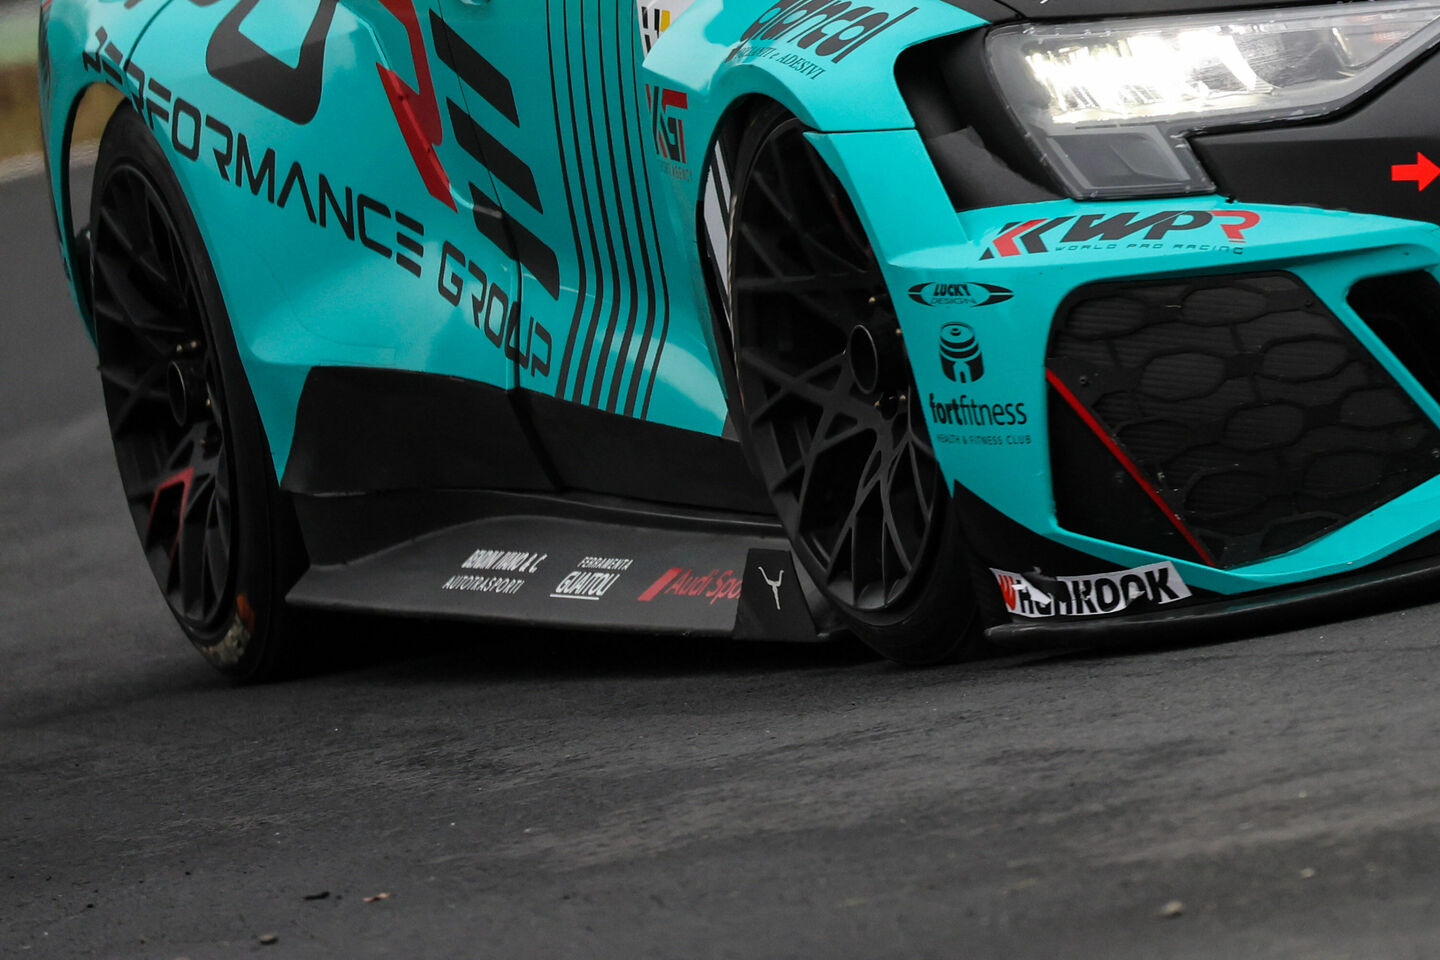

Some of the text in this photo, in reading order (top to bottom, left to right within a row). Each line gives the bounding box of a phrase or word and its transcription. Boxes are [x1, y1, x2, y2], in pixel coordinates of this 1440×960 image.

[776, 53, 827, 81] ADESIVI
[1055, 243, 1118, 252] WORLD
[1125, 242, 1164, 250] PRO
[933, 284, 971, 296] LUCKY
[438, 240, 553, 378] GROUP
[929, 392, 1028, 426] fortfitness
[442, 574, 526, 595] AUTOTRASPORTI
[663, 568, 720, 597] Audi
